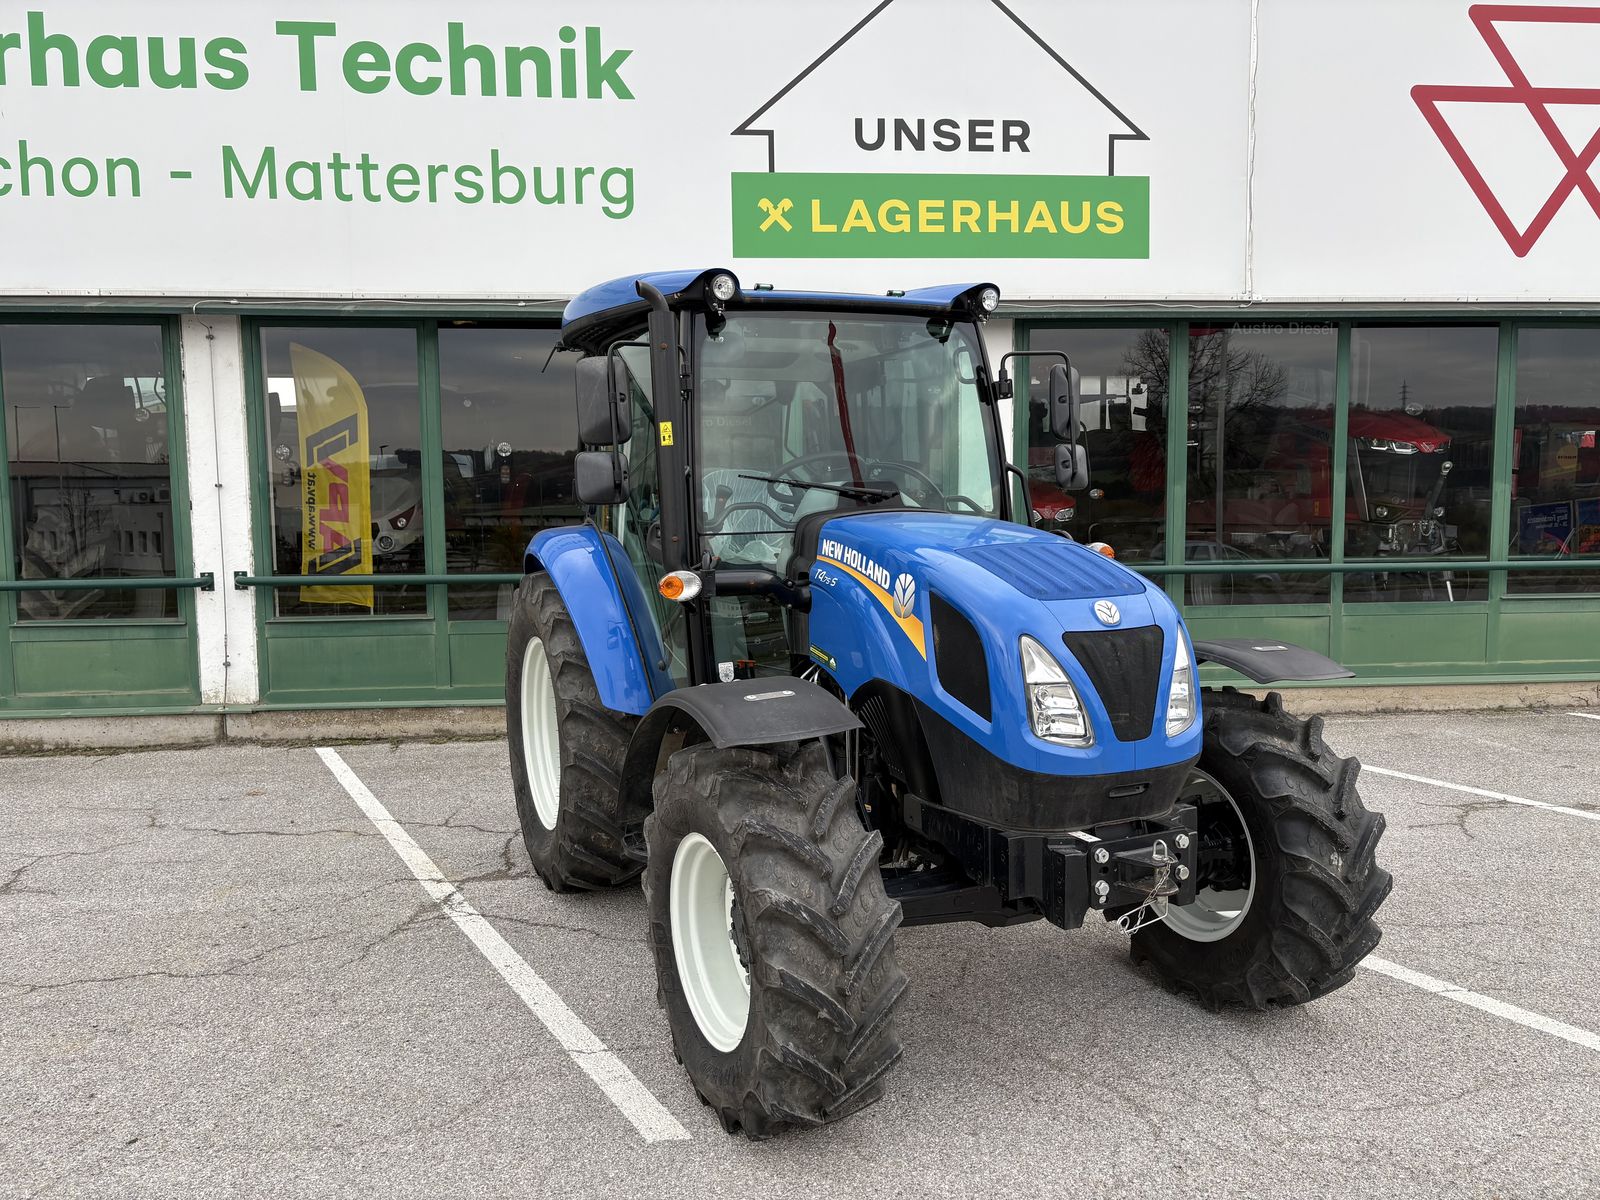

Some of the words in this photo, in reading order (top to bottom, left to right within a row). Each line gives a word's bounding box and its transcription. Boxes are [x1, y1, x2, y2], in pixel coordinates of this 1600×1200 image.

[276, 21, 635, 100] Technik
[855, 118, 1031, 152] UNSER
[222, 145, 635, 219] Mattersburg
[811, 199, 1125, 234] LAGERHAUS
[1231, 321, 1284, 335] Austro
[1288, 321, 1334, 335] Diesel
[822, 539, 844, 561] NEW
[844, 546, 891, 590] HOLLAND
